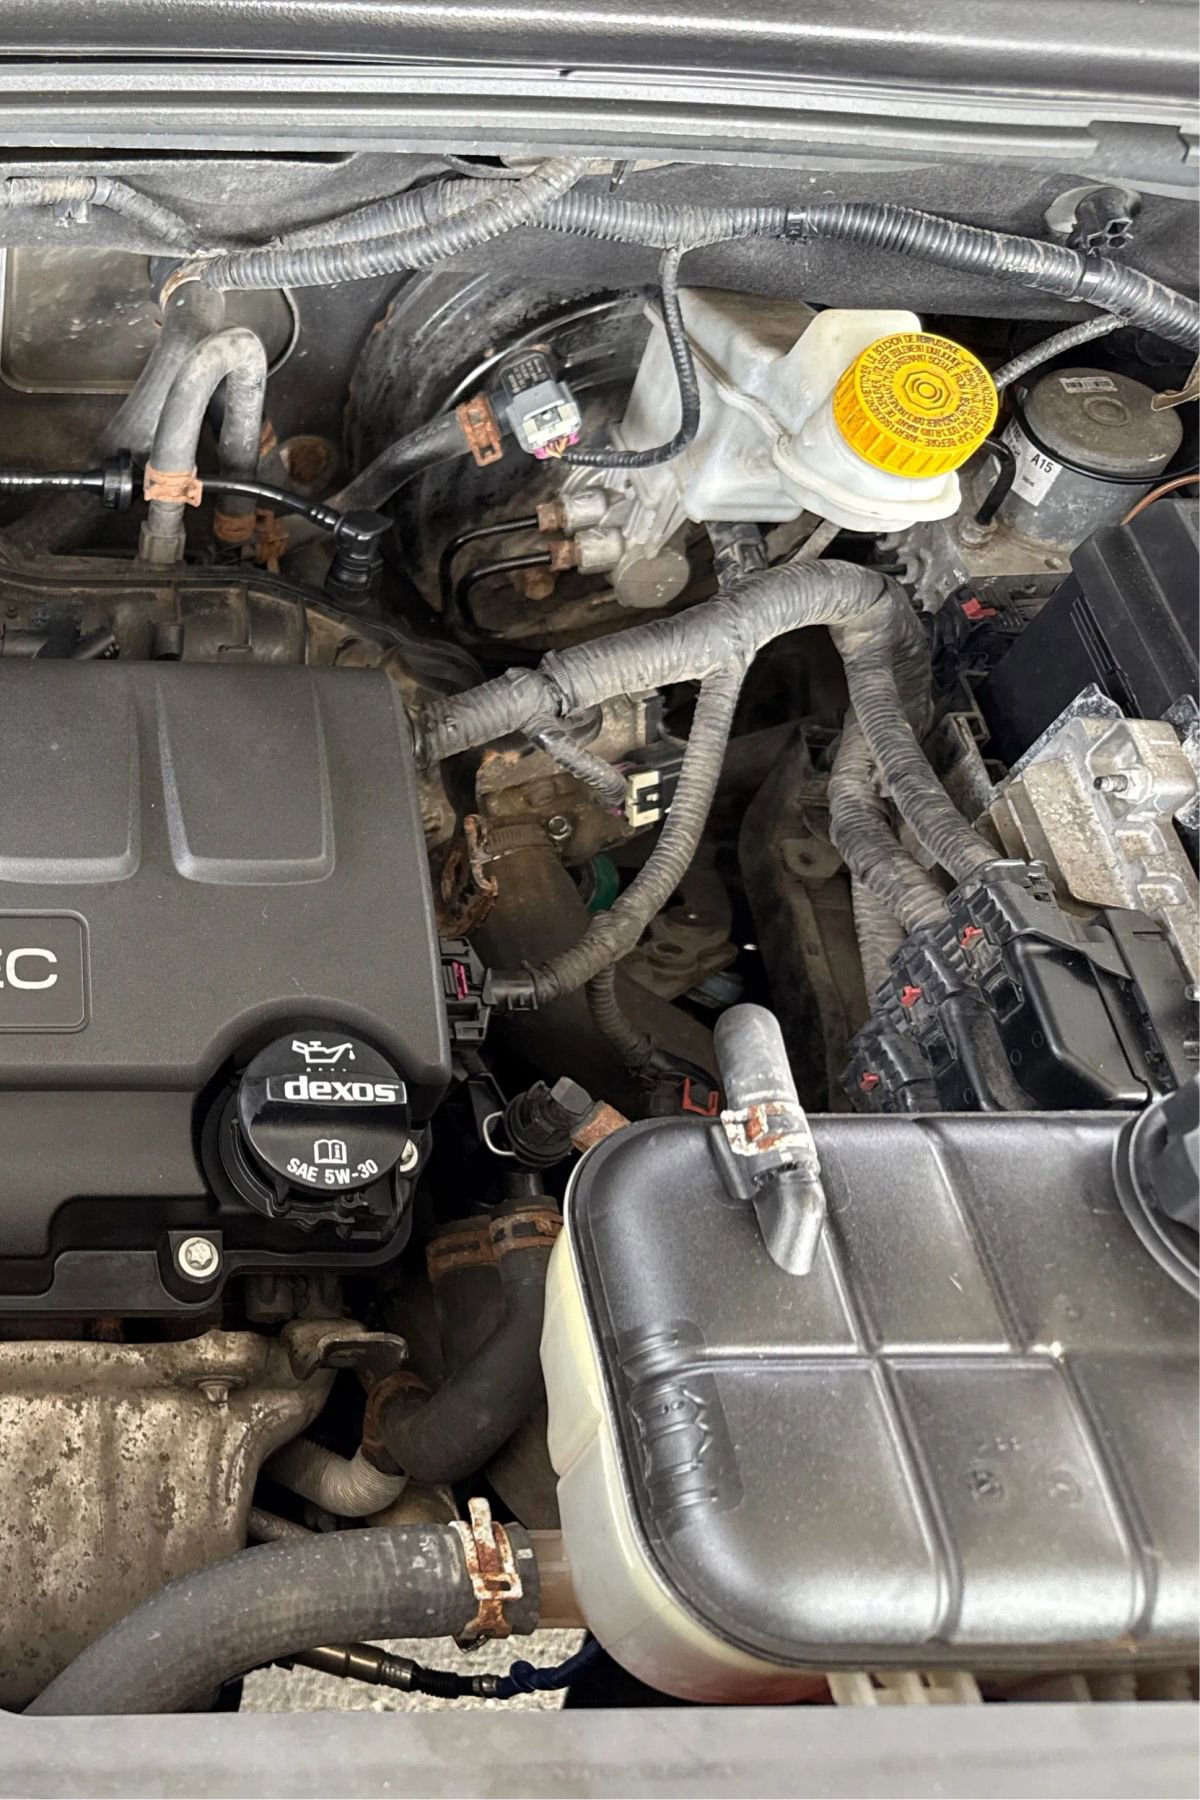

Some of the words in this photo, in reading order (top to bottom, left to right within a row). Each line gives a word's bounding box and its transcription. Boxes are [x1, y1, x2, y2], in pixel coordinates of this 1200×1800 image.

[863, 352, 878, 365] LE
[902, 334, 915, 343] DE
[883, 407, 897, 419] DE
[924, 436, 957, 448] BEFORE
[954, 429, 975, 445] CAP
[1031, 453, 1054, 473] A15
[284, 1075, 400, 1103] dexos
[287, 1158, 319, 1182] SAE
[324, 1159, 378, 1185] 5W-30
